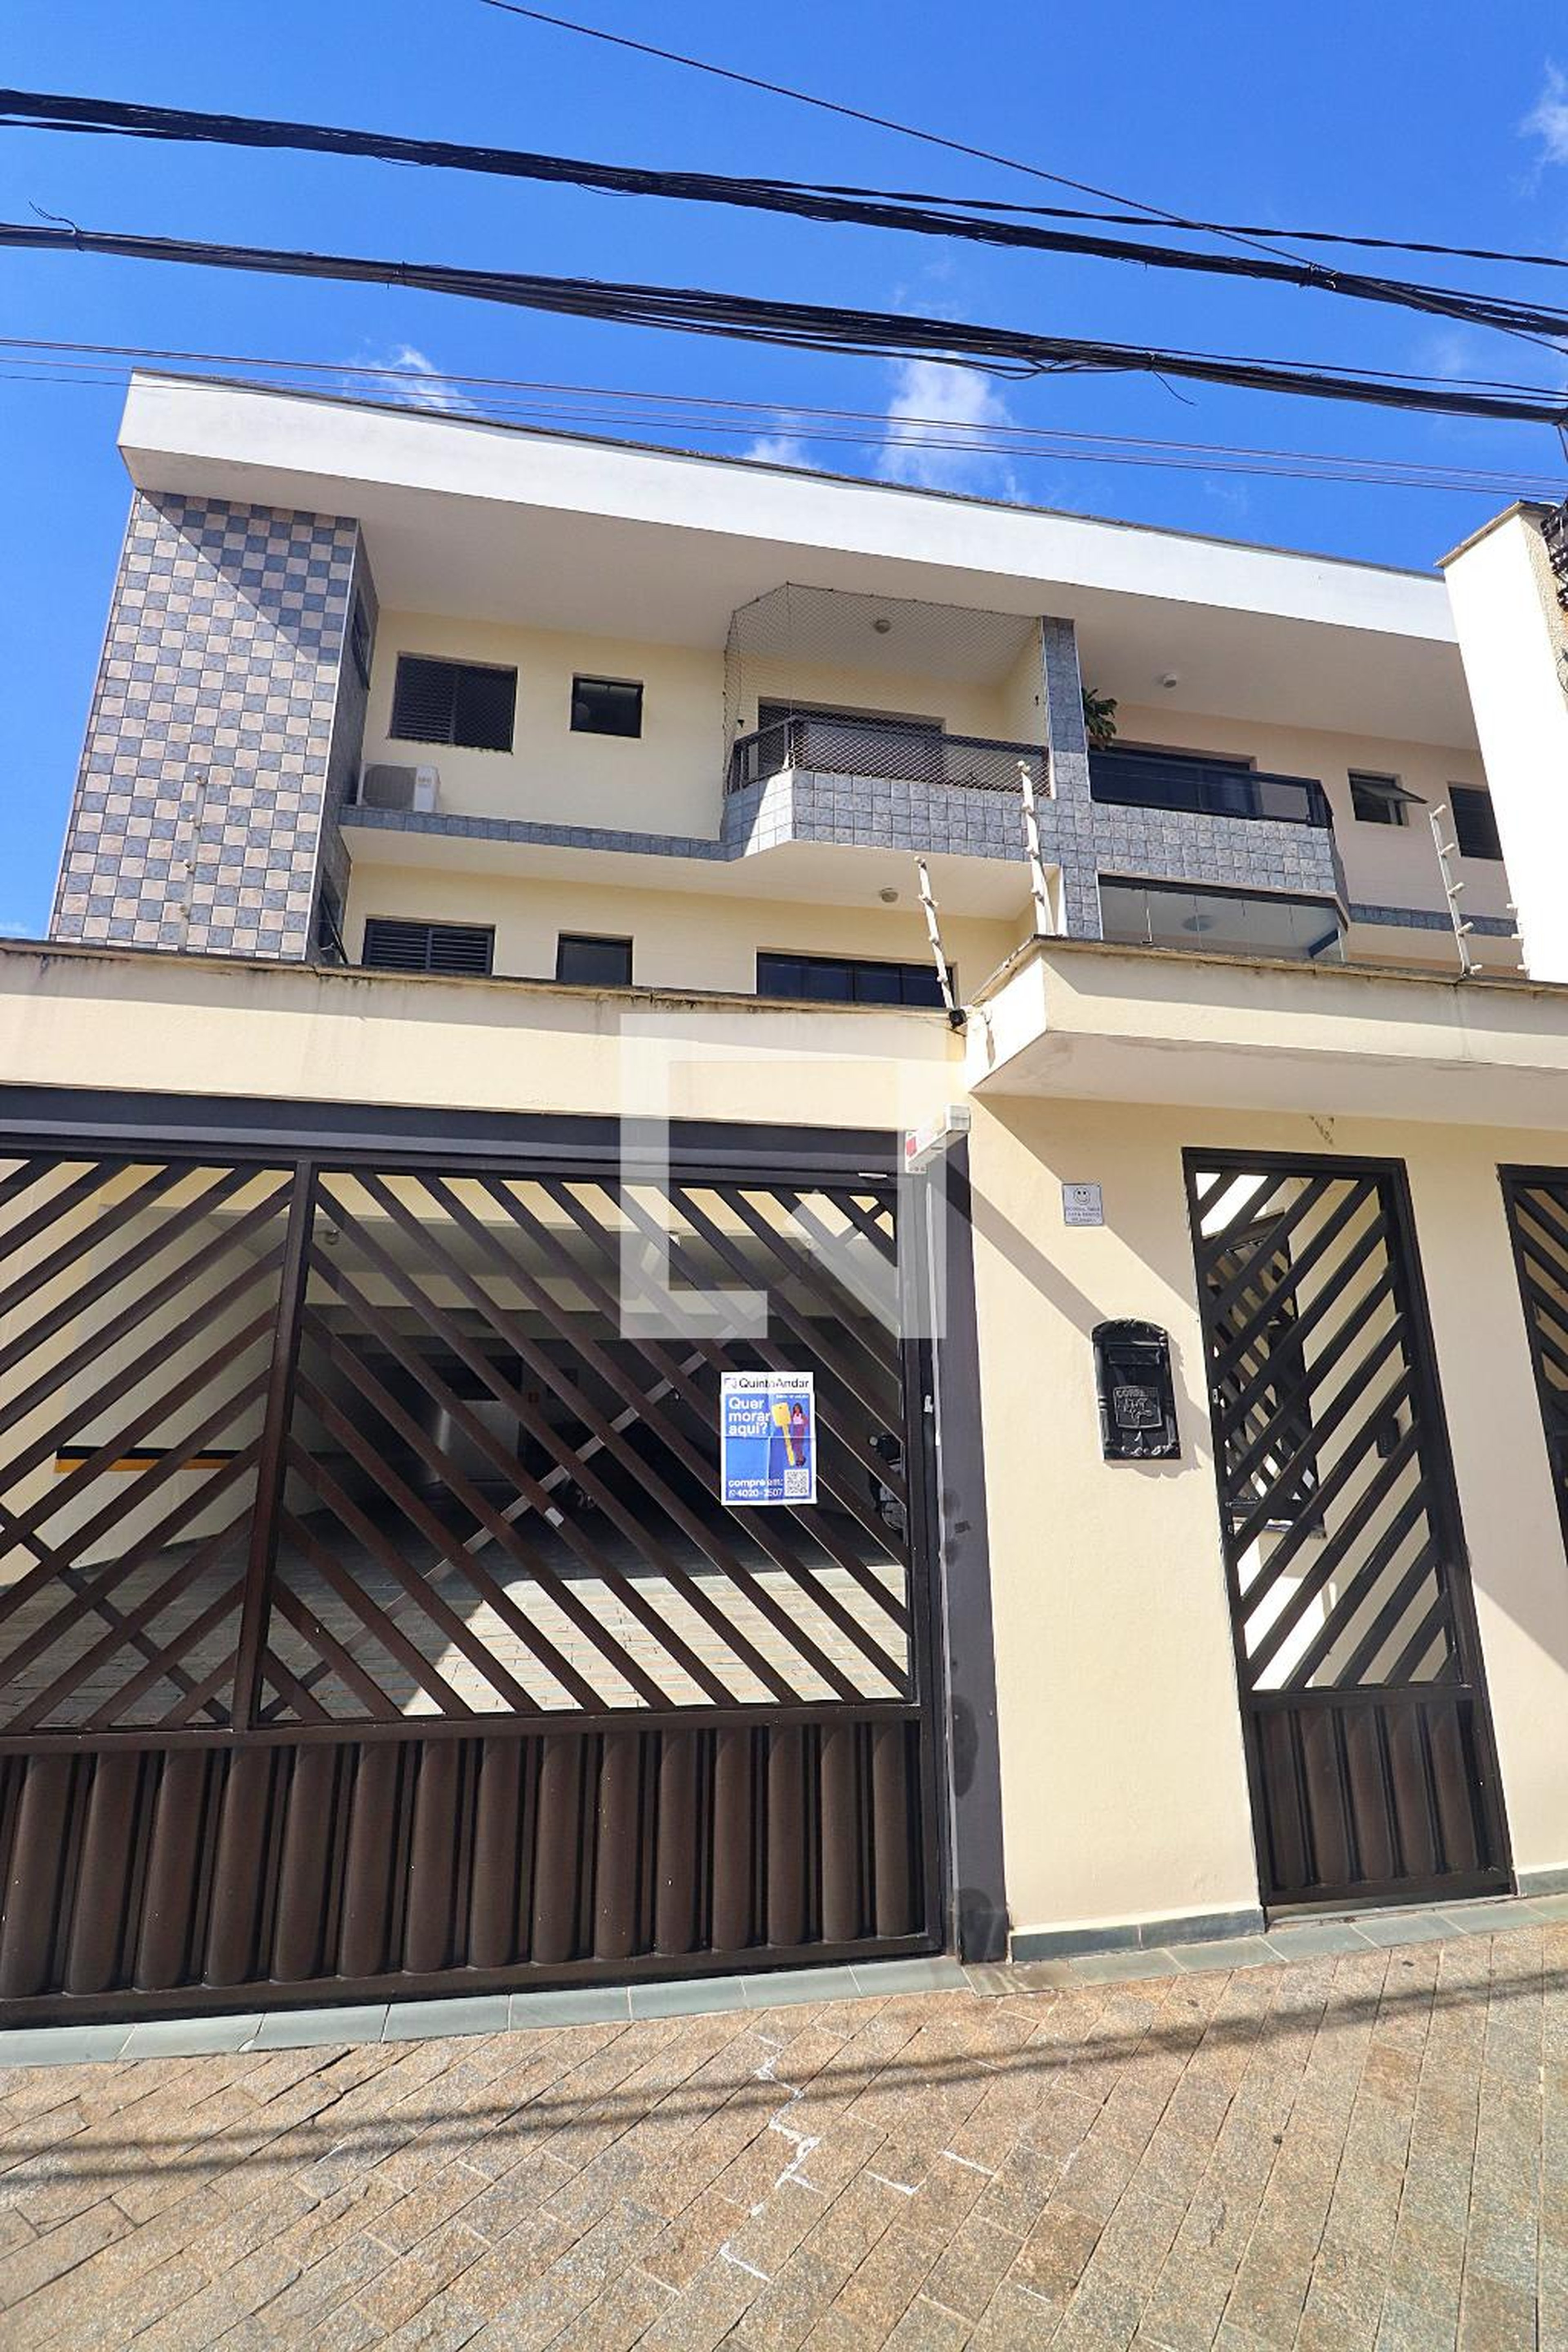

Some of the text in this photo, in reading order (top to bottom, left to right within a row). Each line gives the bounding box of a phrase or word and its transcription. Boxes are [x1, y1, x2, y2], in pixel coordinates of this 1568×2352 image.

[729, 1397, 765, 1410] Quer
[729, 1412, 771, 1422] morar
[729, 1422, 768, 1435] aqui?
